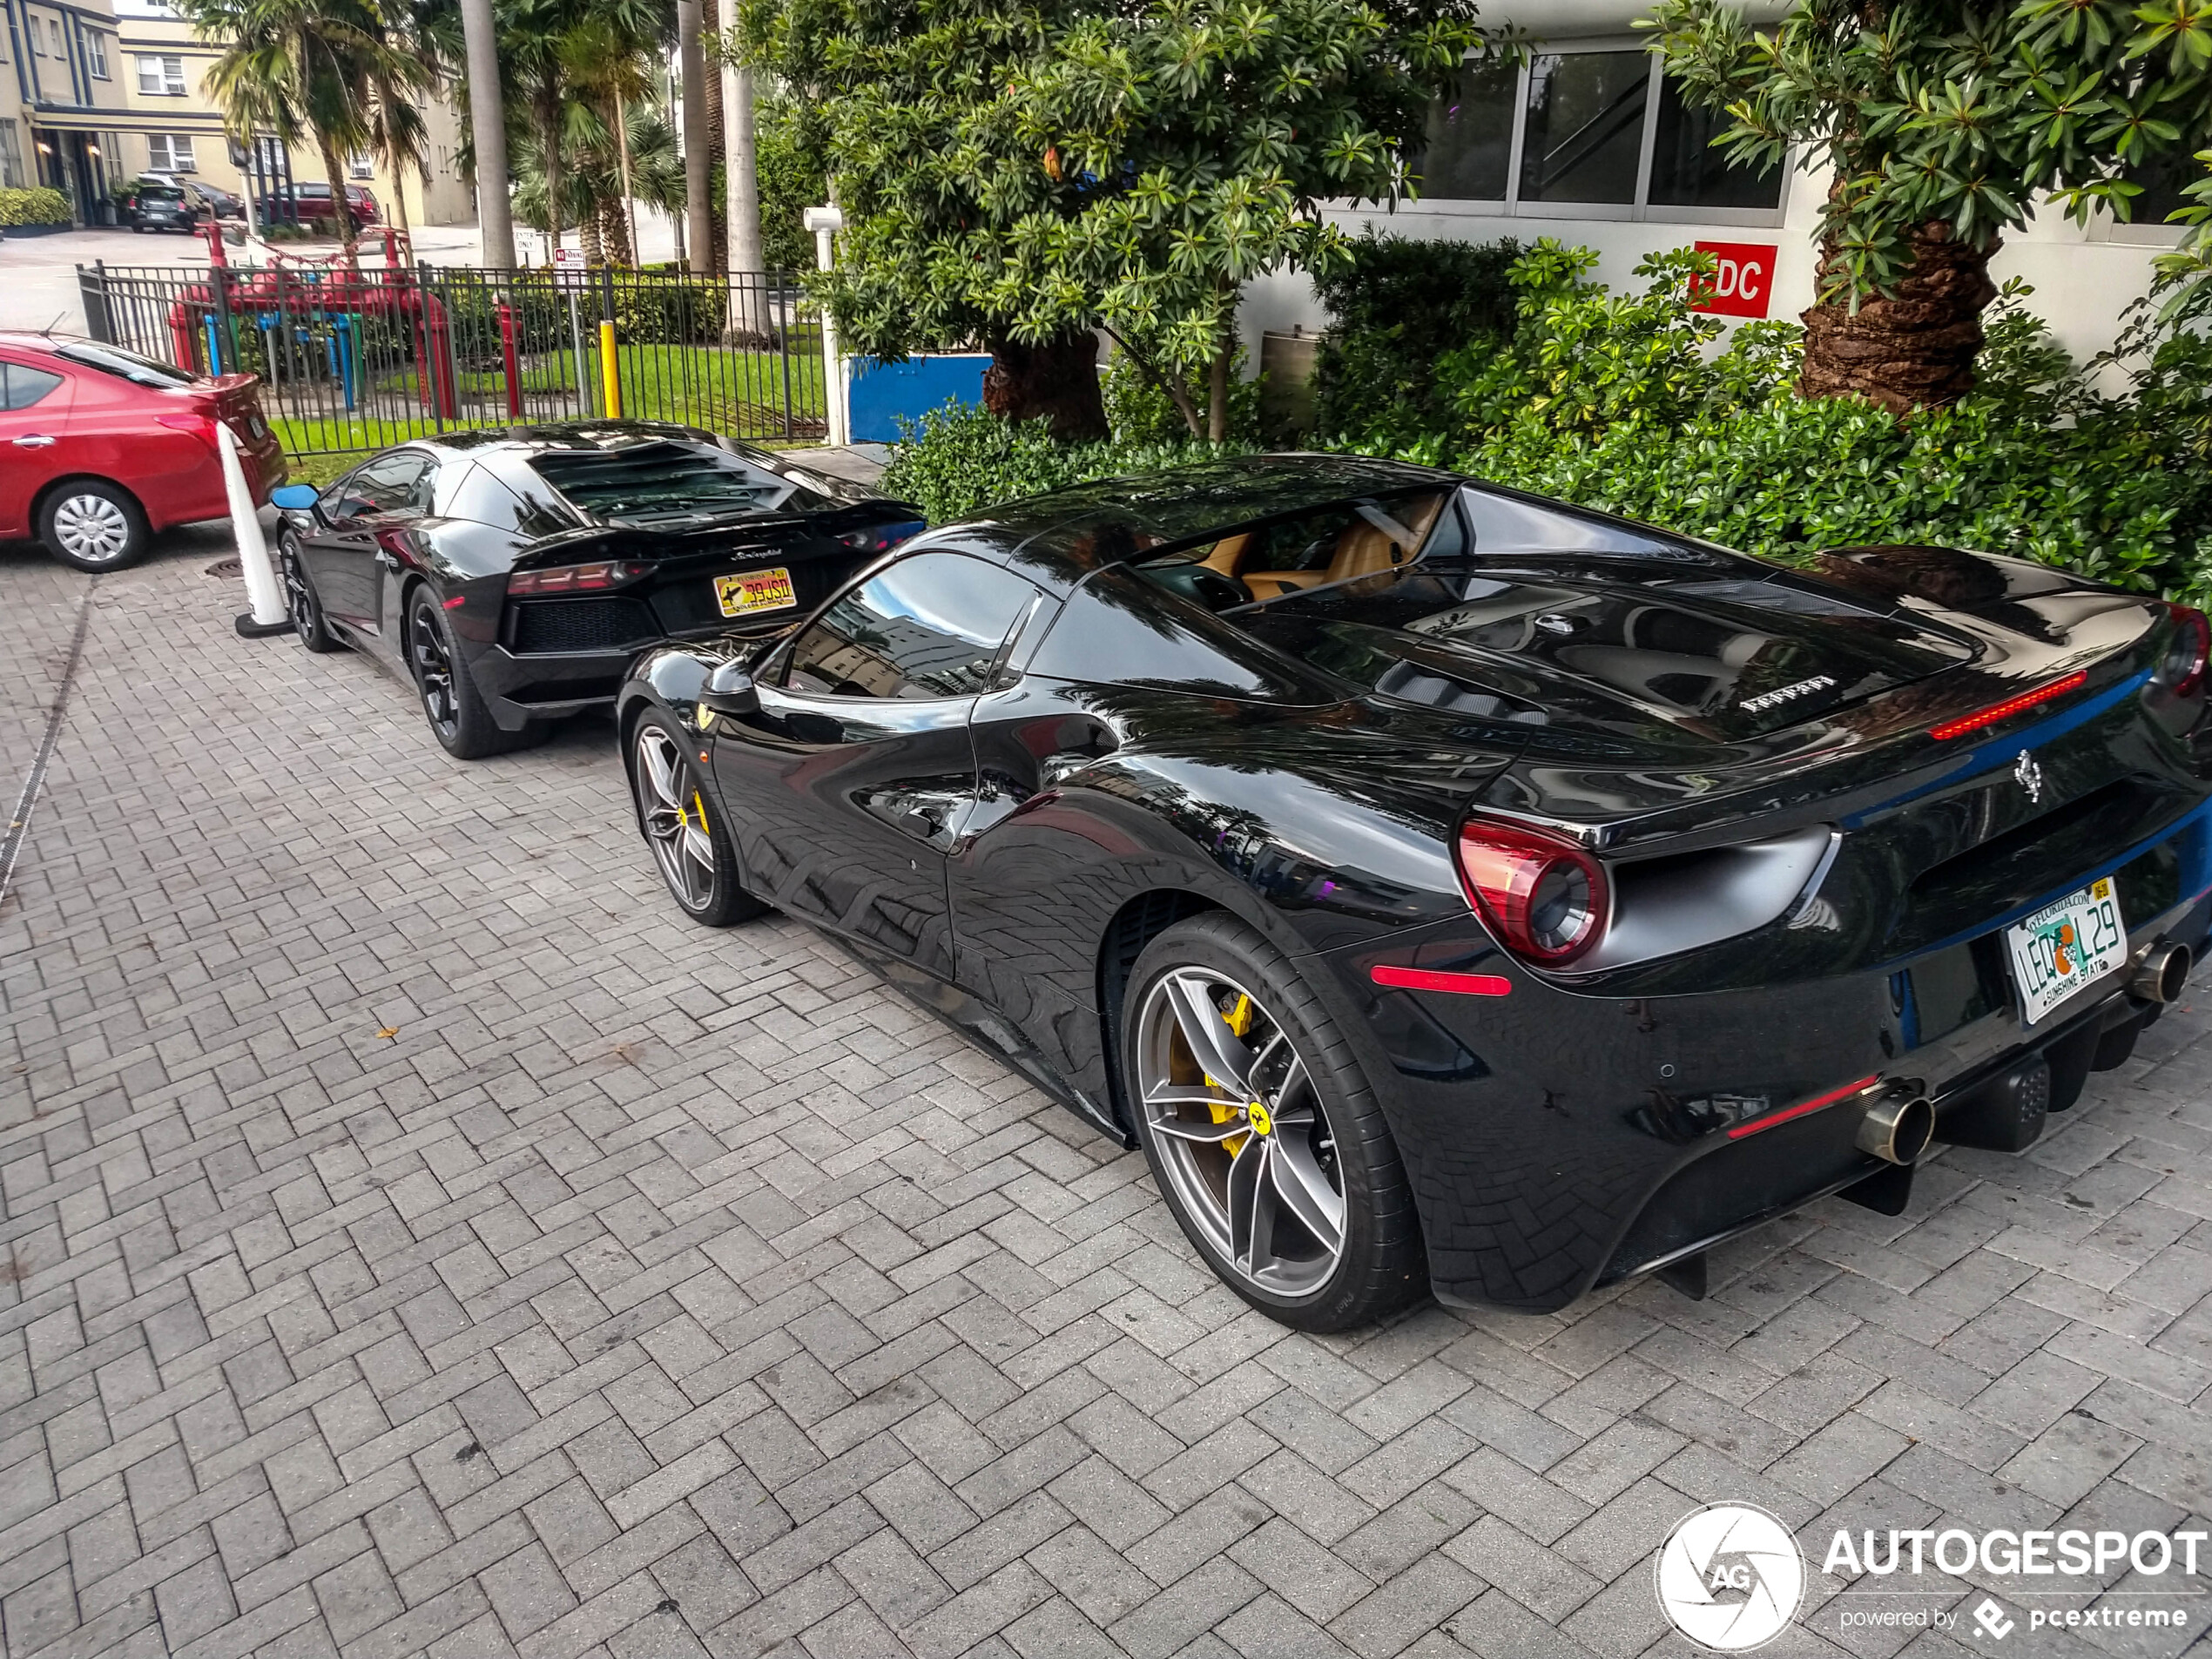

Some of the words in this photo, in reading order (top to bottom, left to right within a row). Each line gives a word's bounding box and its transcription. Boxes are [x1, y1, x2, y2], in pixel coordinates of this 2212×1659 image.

[557, 250, 564, 260] NO
[2026, 894, 2090, 937] MYFLORIDA.COM
[2074, 900, 2119, 962] L29
[2046, 974, 2079, 1005] SUNSHINE
[2079, 959, 2104, 983] STATE
